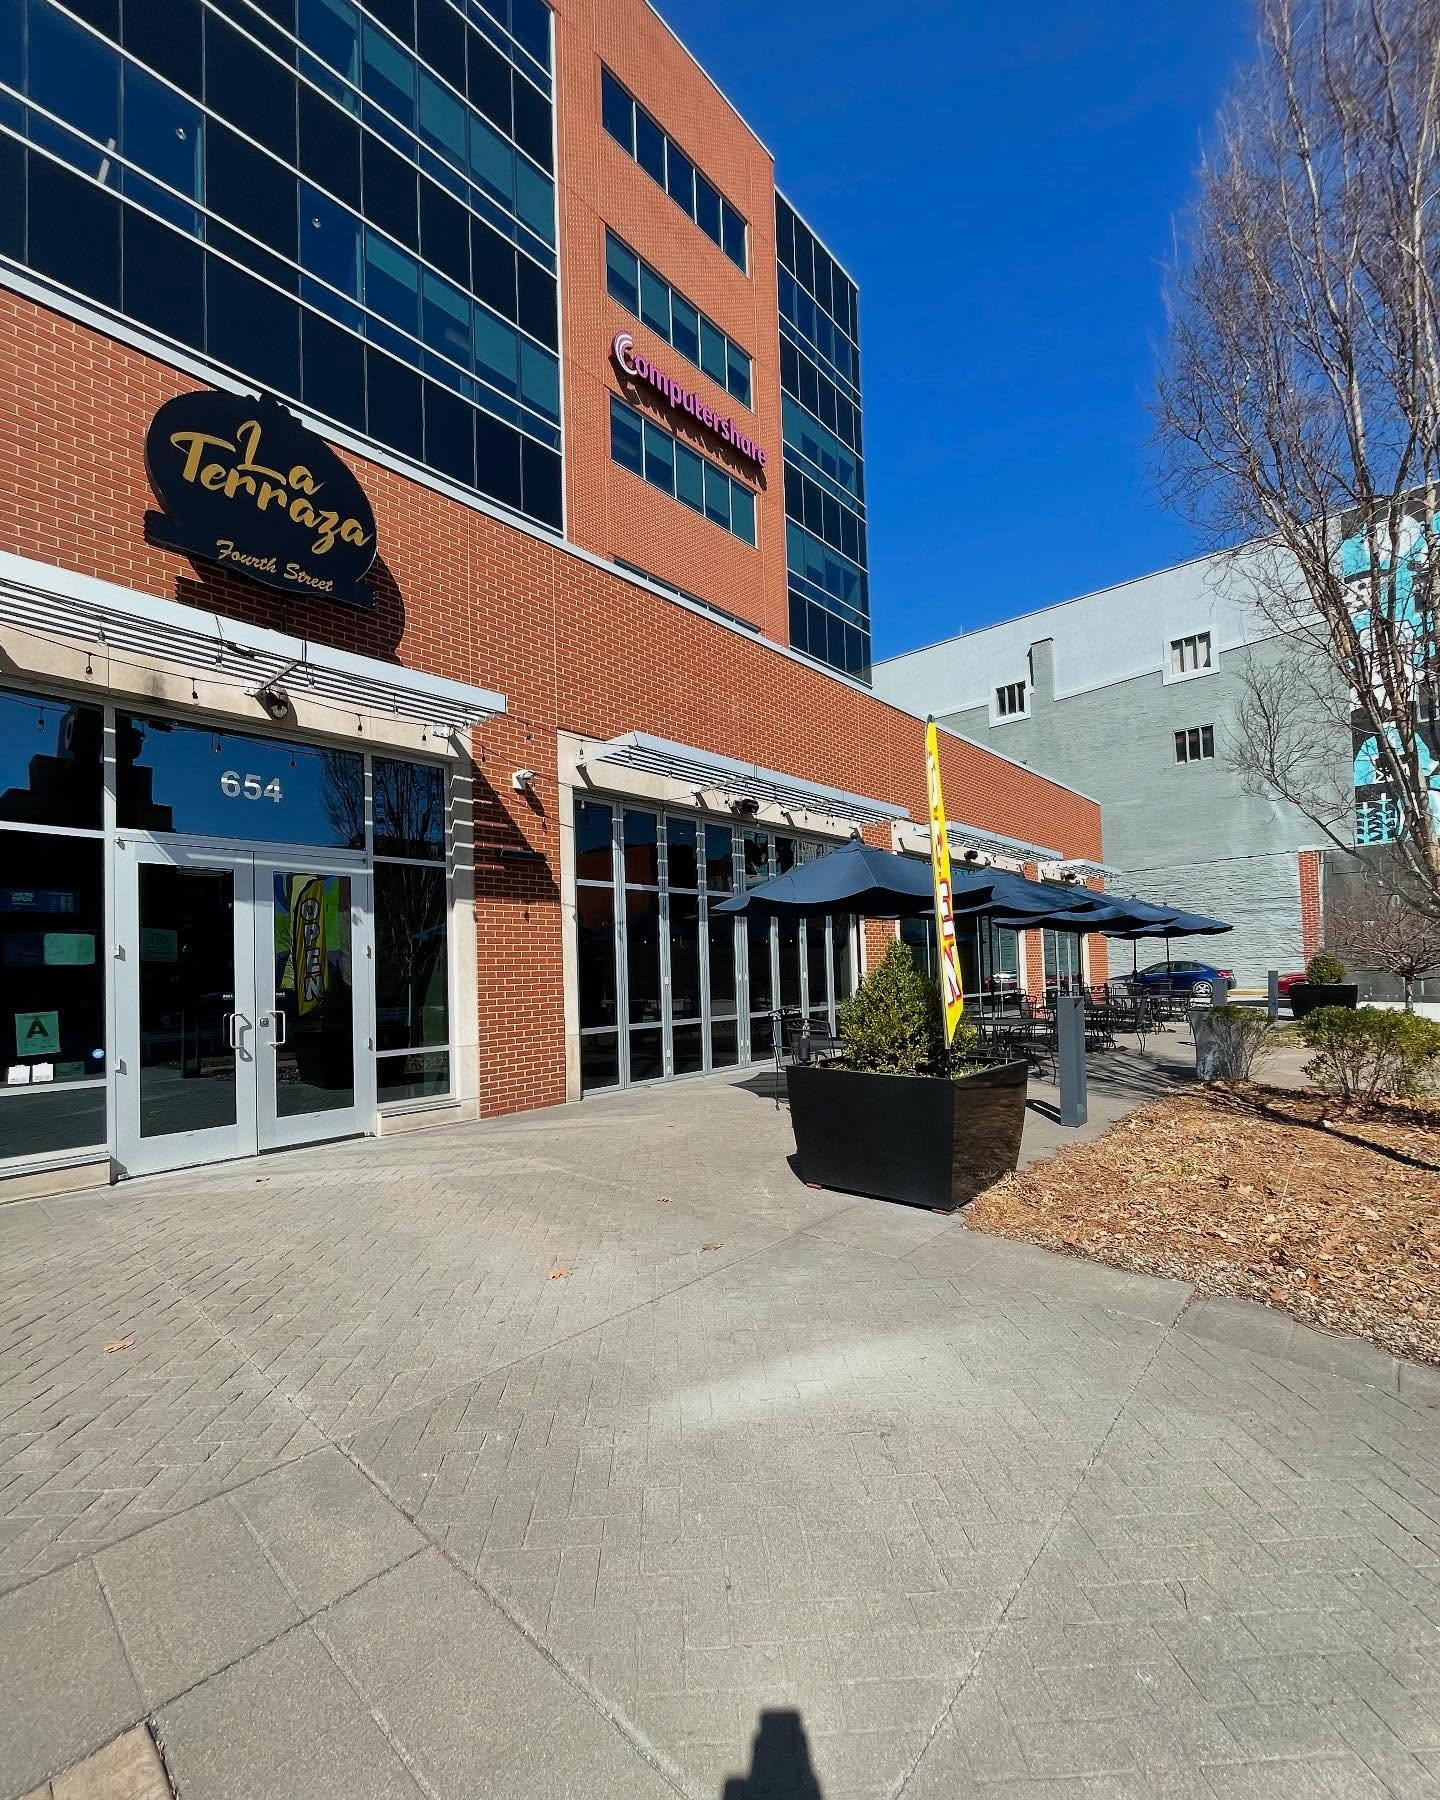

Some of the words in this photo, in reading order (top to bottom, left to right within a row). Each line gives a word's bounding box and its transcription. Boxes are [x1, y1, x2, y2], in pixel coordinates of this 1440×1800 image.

[613, 330, 767, 467] Computershare
[170, 431, 373, 554] Terraza
[237, 420, 327, 496] La
[216, 539, 277, 574] Fourth
[284, 563, 333, 592] Street
[221, 770, 283, 803] 654
[301, 898, 323, 1002] OPEN
[26, 1016, 50, 1039] A
